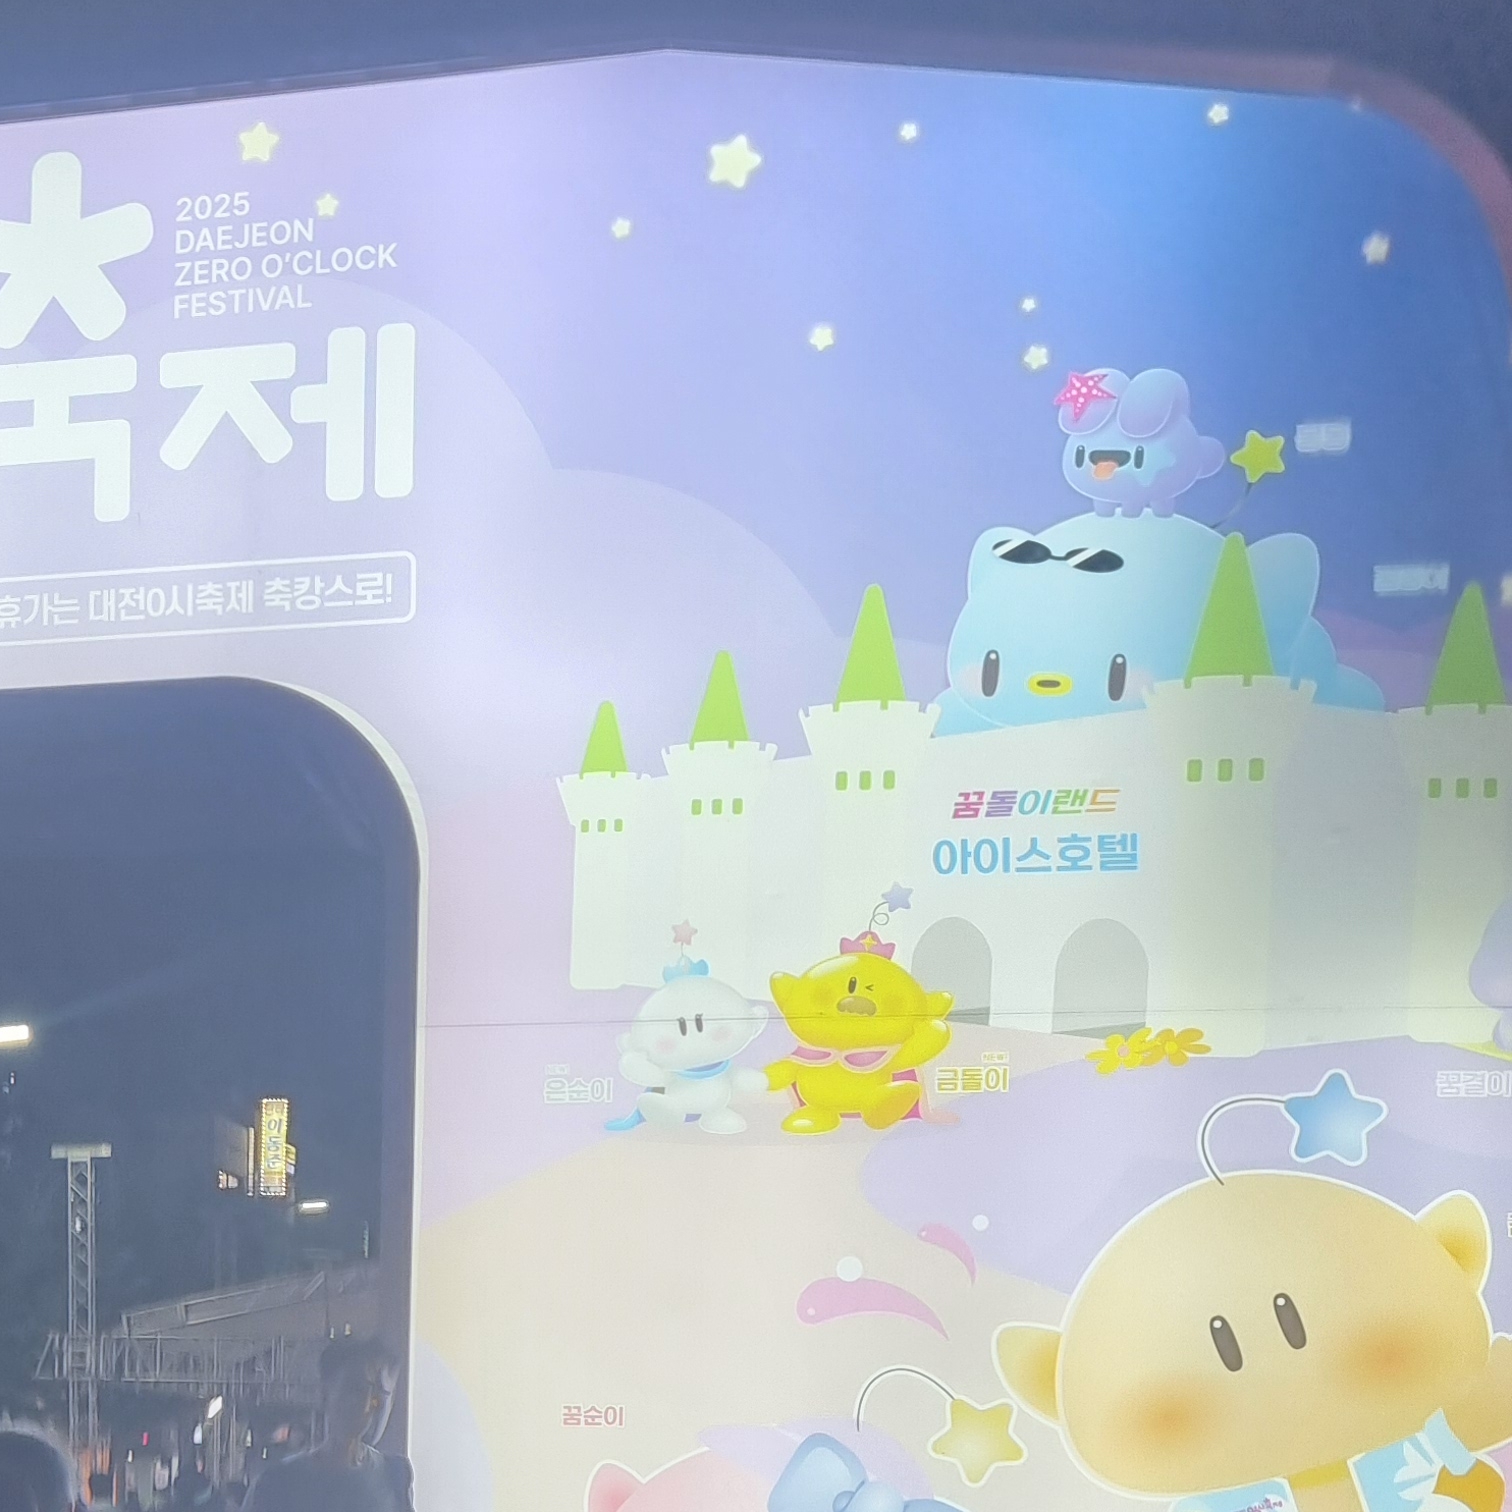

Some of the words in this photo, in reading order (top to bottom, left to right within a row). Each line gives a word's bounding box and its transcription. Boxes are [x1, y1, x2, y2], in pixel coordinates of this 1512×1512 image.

[176, 191, 250, 222] 2025
[175, 217, 314, 254] DAEJEON
[174, 256, 253, 286] ZERO
[261, 243, 398, 278] O'CLOCK
[174, 284, 313, 319] FESTIVAL
[263, 571, 394, 613] 축캉스로!
[951, 788, 1121, 819] 꿈돌이랜드
[932, 833, 1138, 875] 아이스호텔
[544, 1078, 612, 1103] 은순이
[936, 1067, 1009, 1092] 금돌이
[1436, 1071, 1512, 1097] 꿈결이
[562, 1405, 624, 1427] 꿈순이
